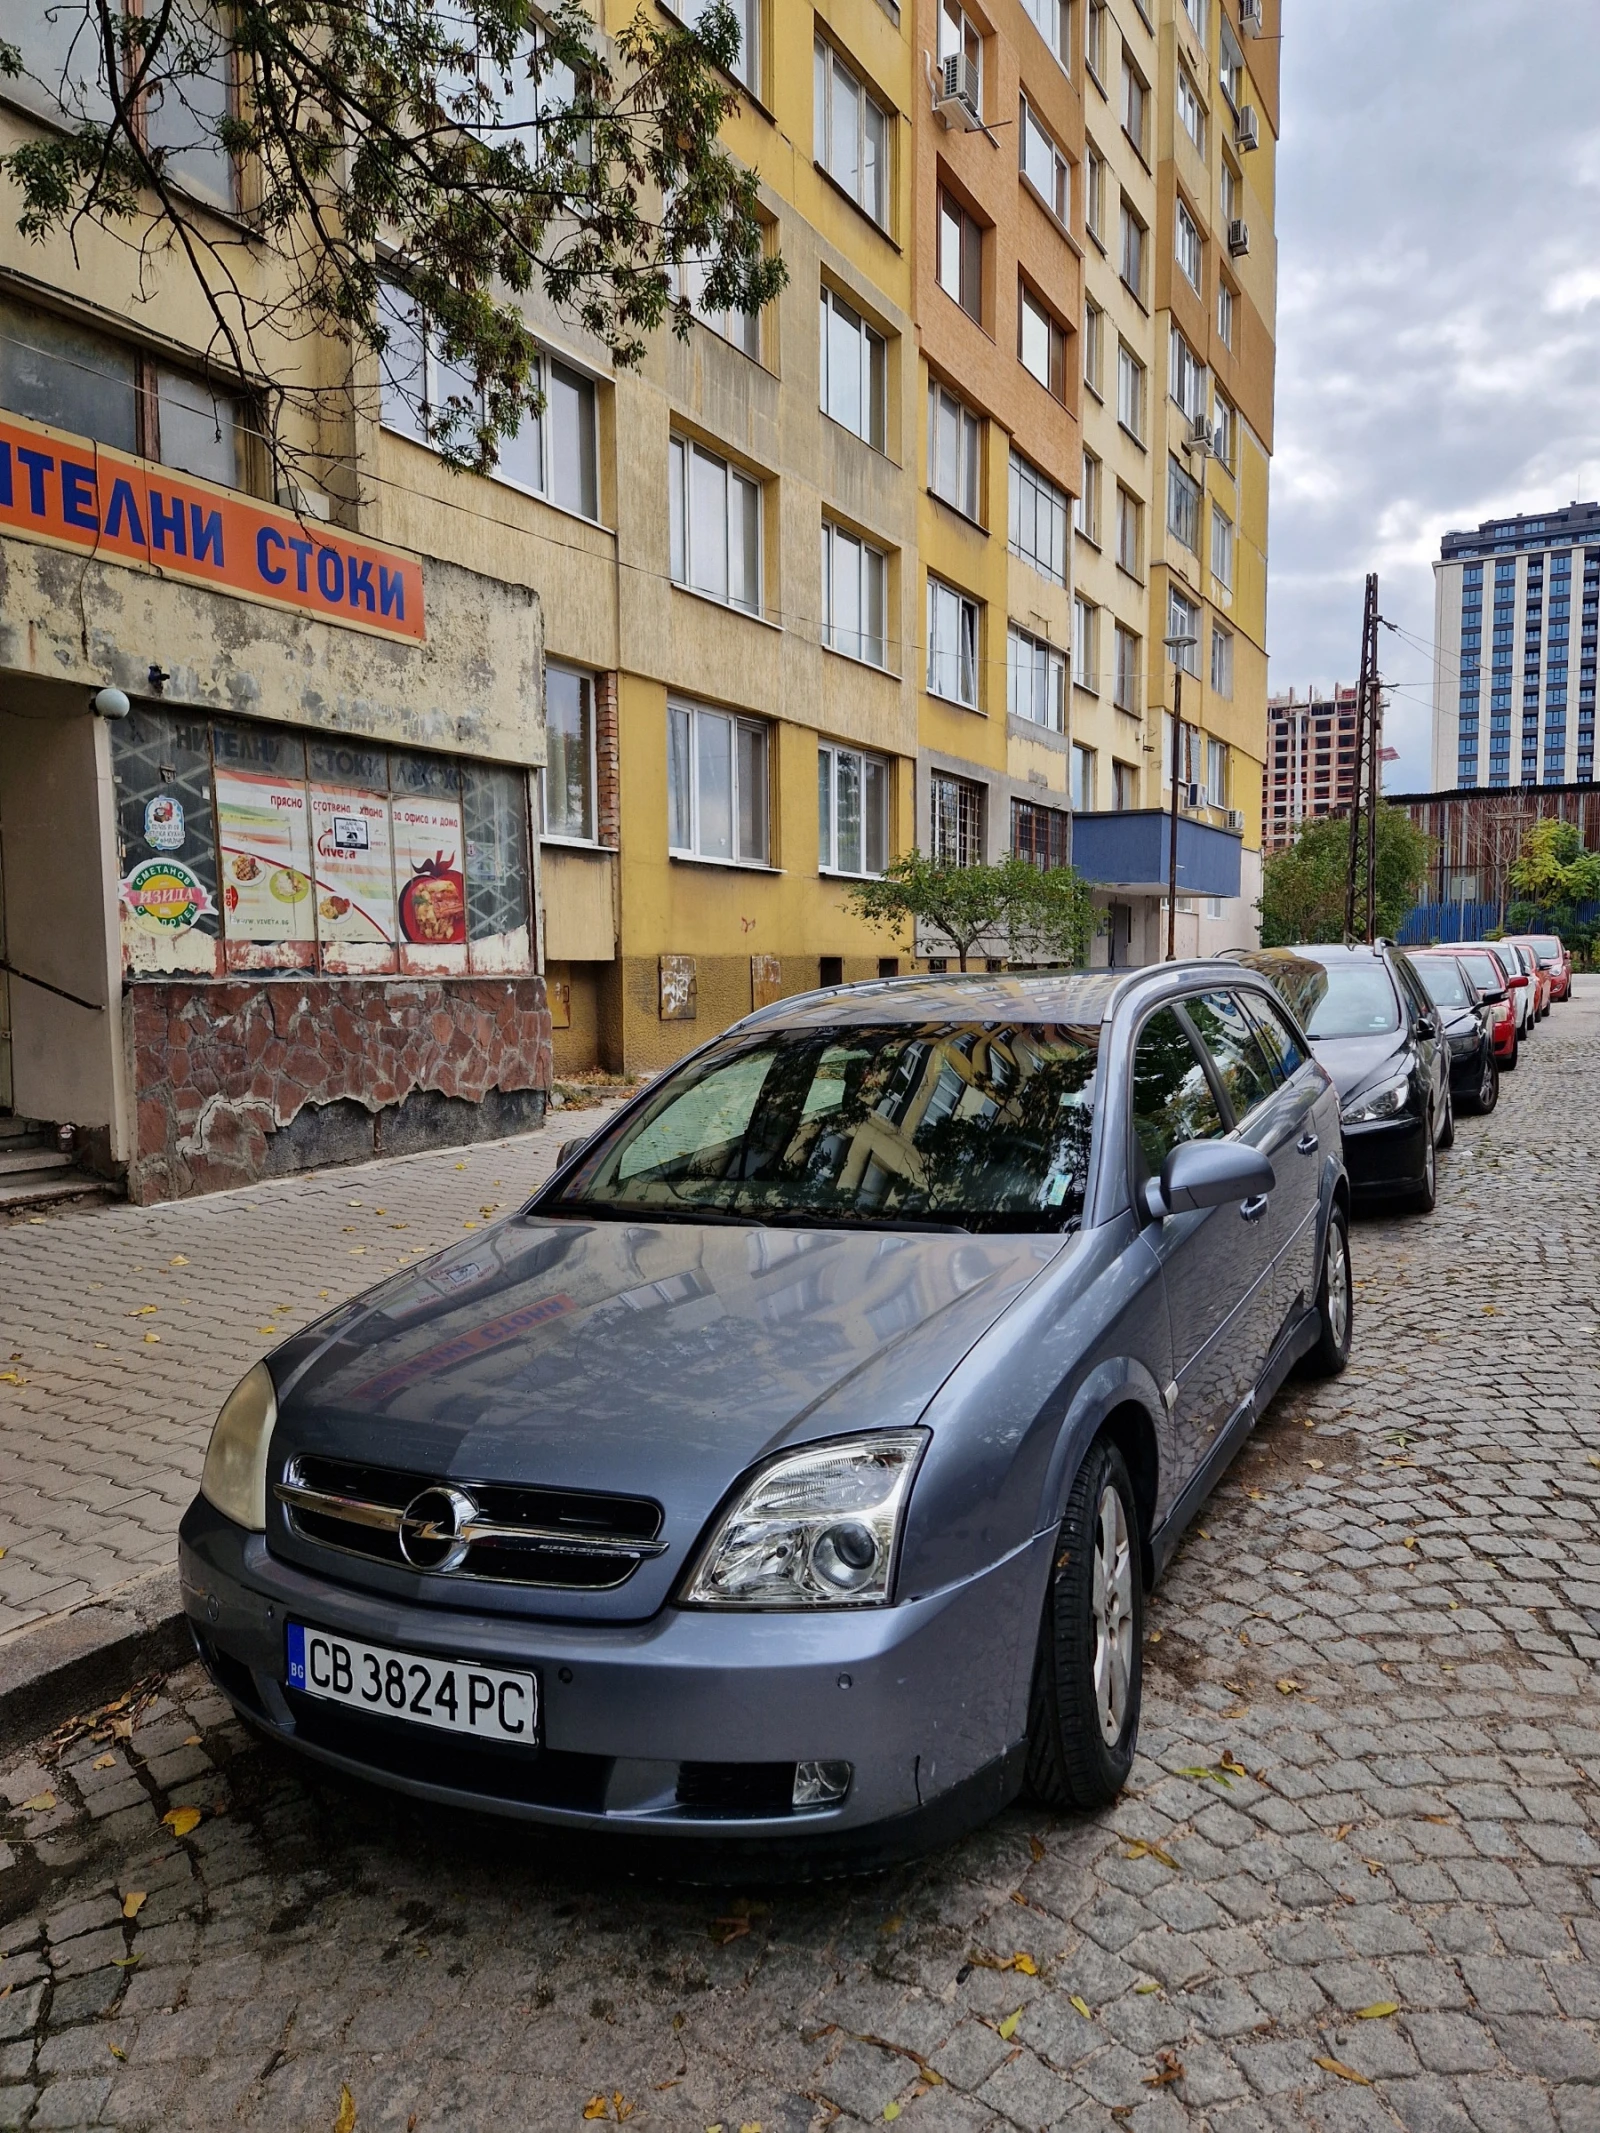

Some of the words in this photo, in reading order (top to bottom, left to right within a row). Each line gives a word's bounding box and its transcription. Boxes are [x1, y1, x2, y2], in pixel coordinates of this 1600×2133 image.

[256, 525, 405, 621] СТОКИ
[270, 795, 303, 810] прясно
[312, 800, 351, 814] сготвена
[393, 811, 402, 821] за
[404, 812, 429, 826] офиса
[440, 816, 458, 828] дома
[136, 865, 191, 886] СМЕТАНОВ
[139, 888, 194, 904] ИЗИДА
[137, 902, 198, 927] СДОЛЕД
[291, 1661, 304, 1679] BG
